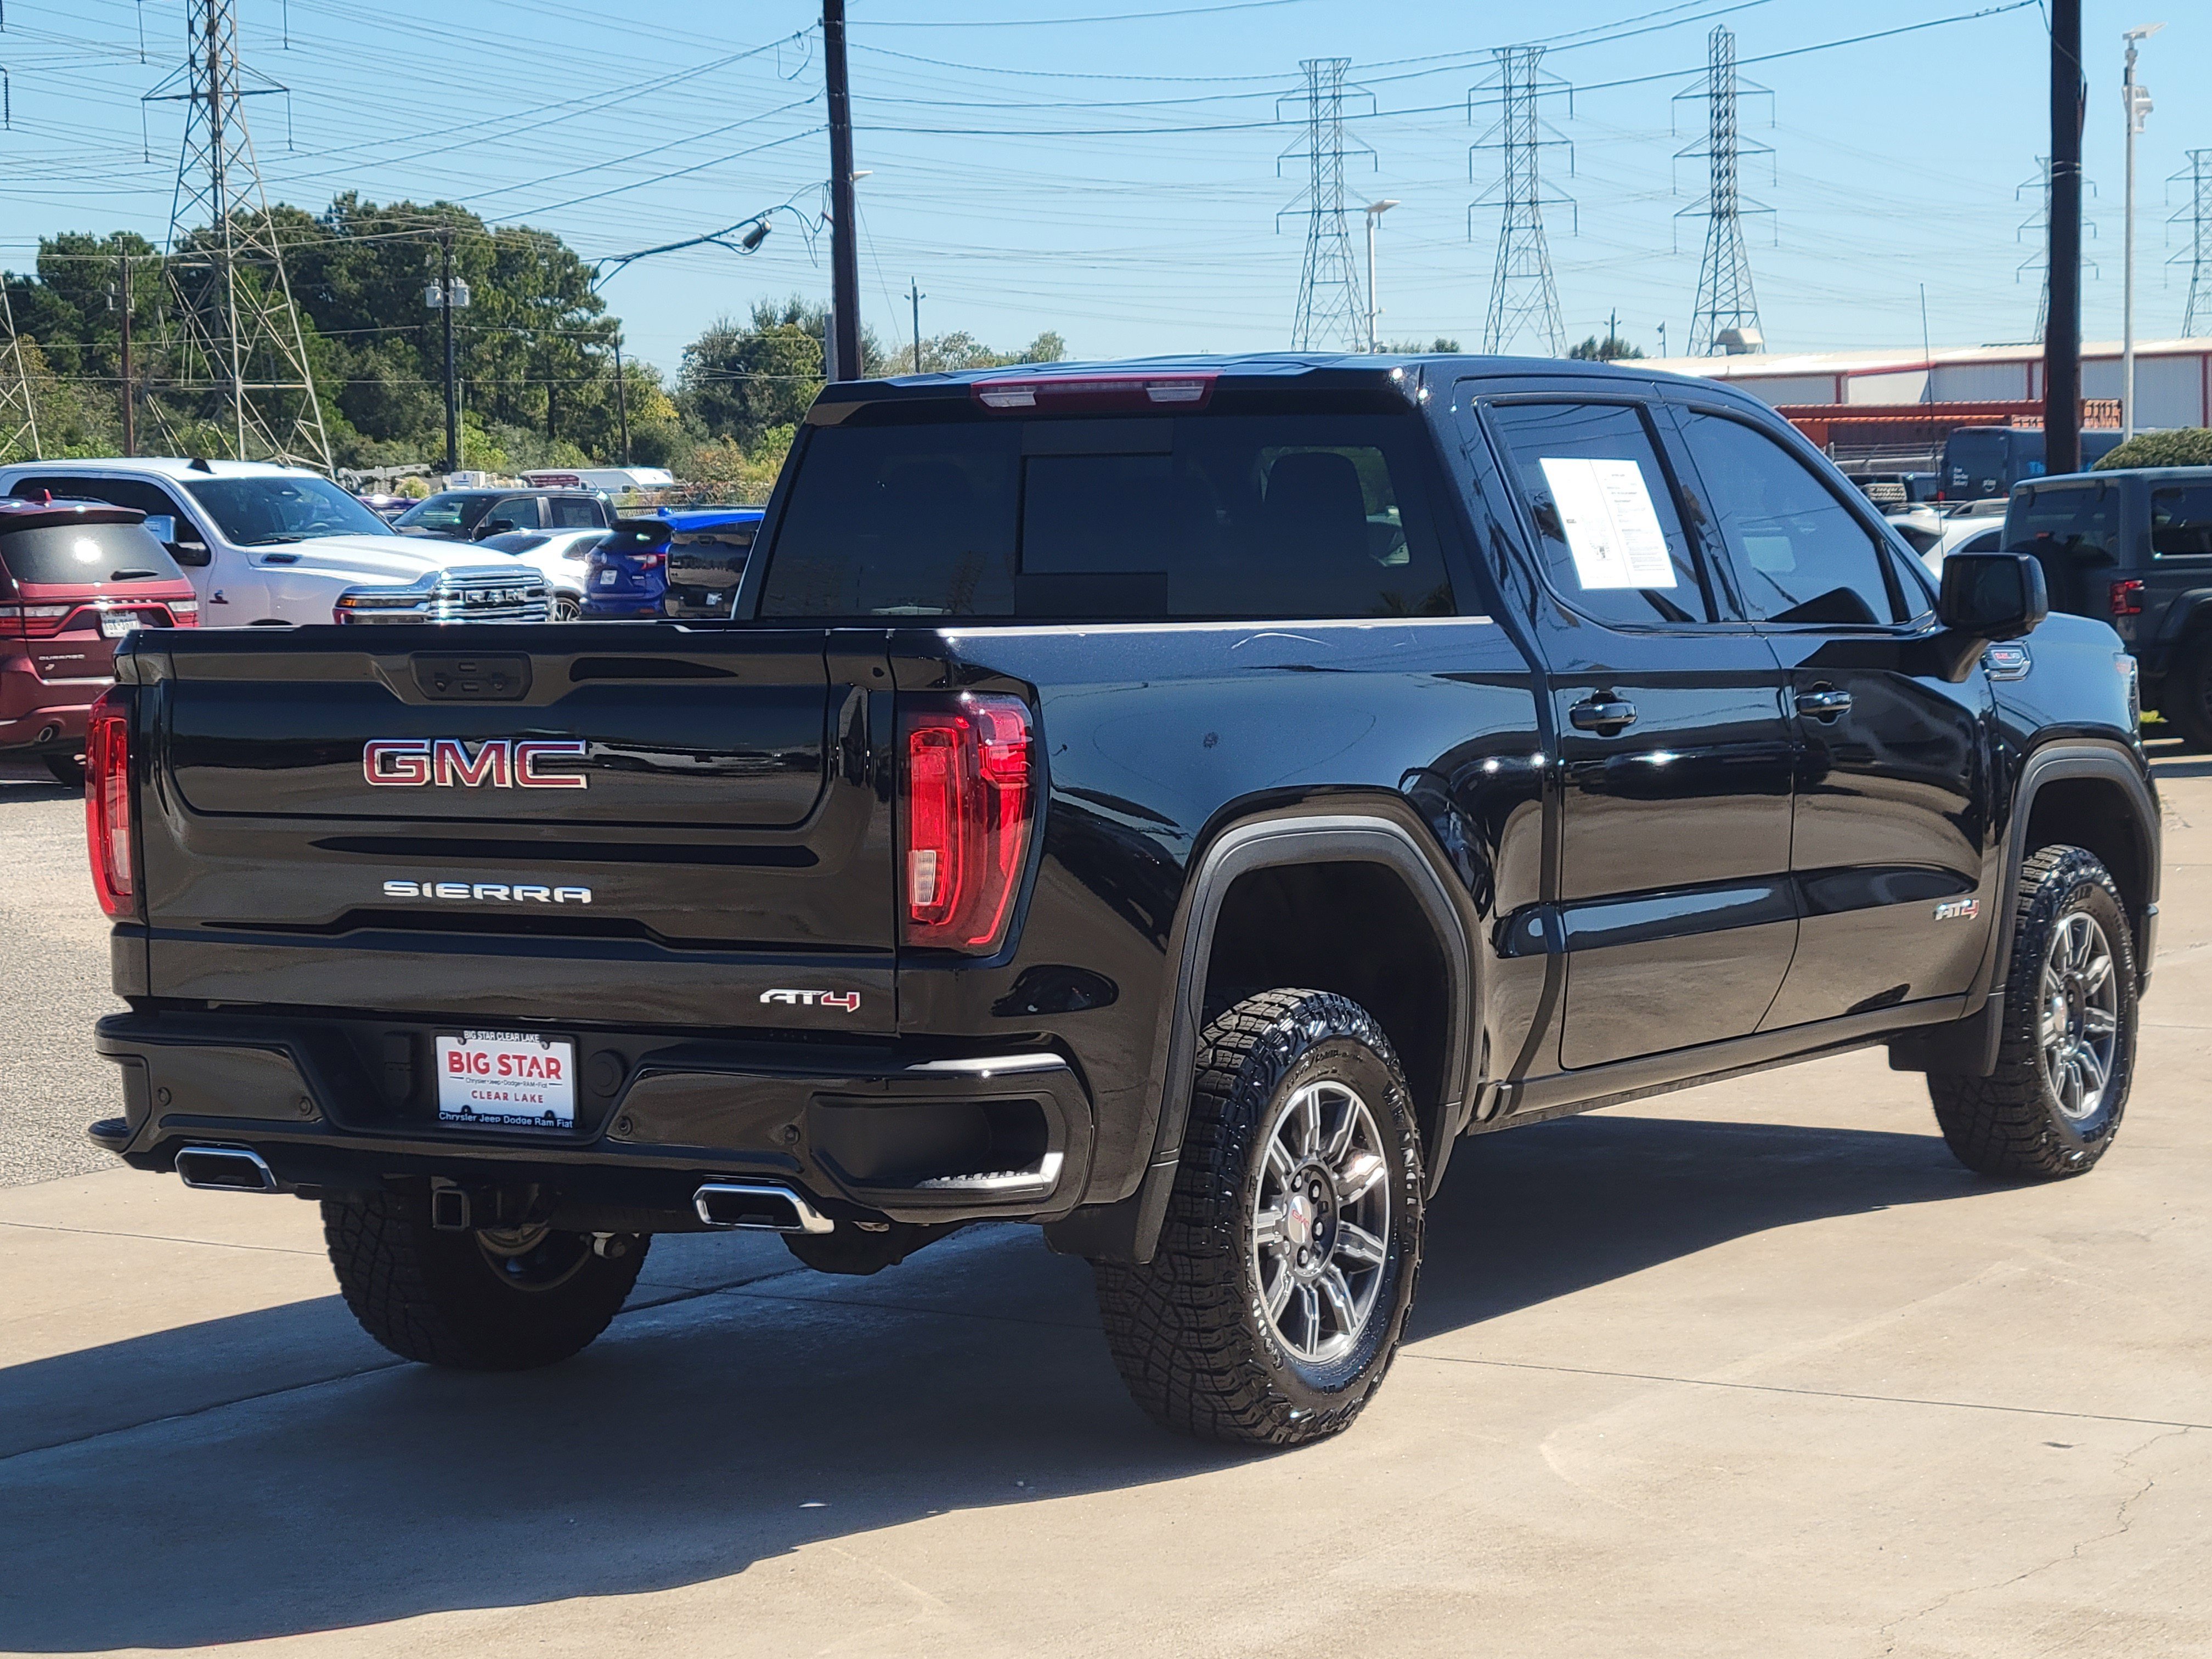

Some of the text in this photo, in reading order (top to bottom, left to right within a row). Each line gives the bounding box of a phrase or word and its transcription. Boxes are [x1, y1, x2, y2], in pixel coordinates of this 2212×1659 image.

[466, 588, 525, 604] RAM
[363, 738, 588, 789] GMC
[383, 880, 592, 904] SIERRA
[1935, 899, 1979, 921] AT4
[760, 989, 860, 1012] AT4
[464, 1030, 540, 1043] BIG STAR CLEAR LAKE
[448, 1051, 562, 1080] BIG STAR
[471, 1090, 543, 1103] CLEAR LAKE
[439, 1112, 573, 1128] Chrysler Jeep Dodge Ram Fiat
[1292, 1209, 1310, 1229] GMC
